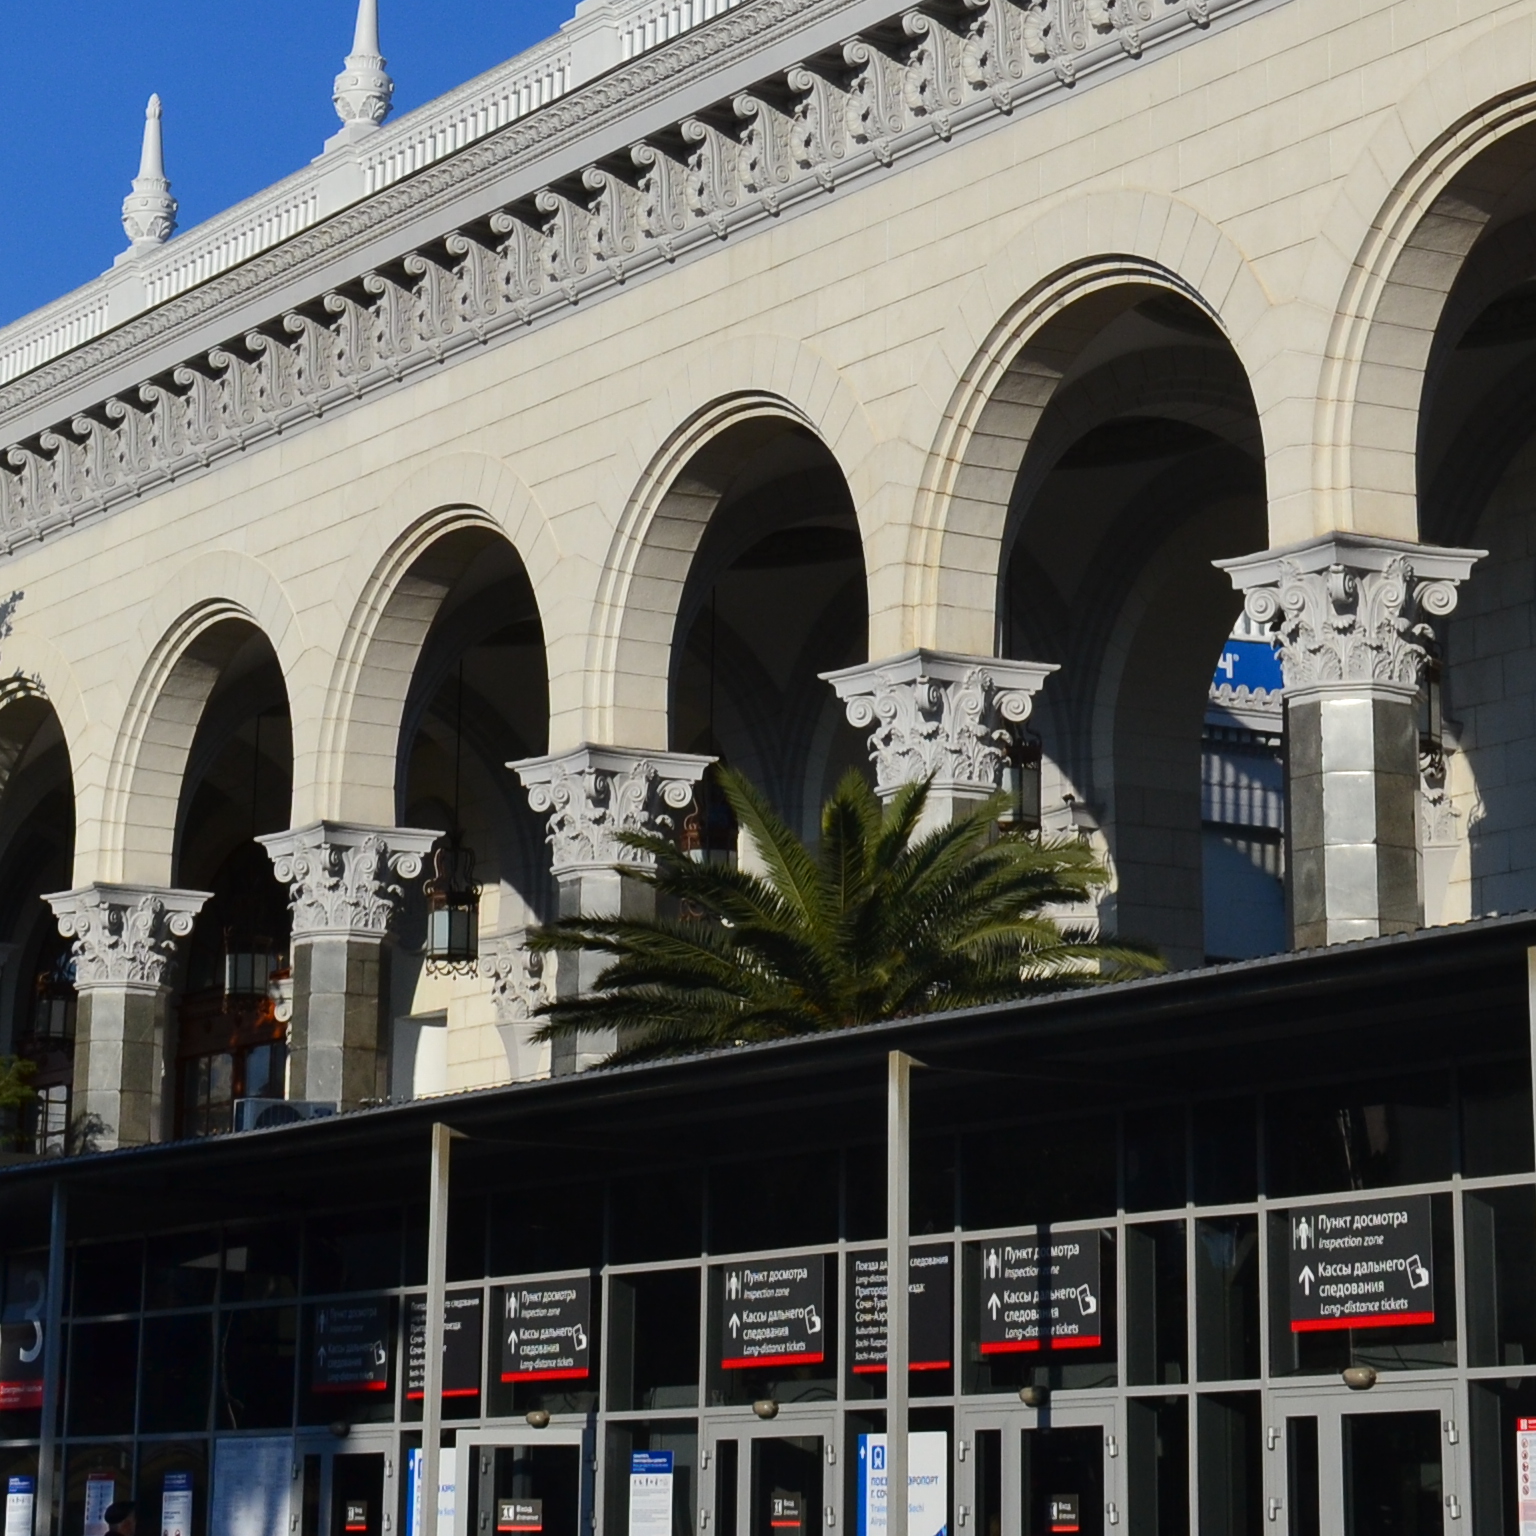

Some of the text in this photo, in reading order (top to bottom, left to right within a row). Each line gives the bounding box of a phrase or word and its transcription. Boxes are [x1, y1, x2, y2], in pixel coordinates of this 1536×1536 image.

[1318, 1211, 1408, 1233] Пункт досмотра
[1319, 1235, 1384, 1252] Inspection zone
[909, 1255, 949, 1268] следования
[1005, 1246, 1033, 1264] Пункт
[1318, 1258, 1406, 1278] Кассы дальнего
[744, 1268, 808, 1286] Пункт досмотра
[1004, 1290, 1032, 1304] Кассы
[1319, 1281, 1385, 1298] следования
[743, 1308, 804, 1323] Кассы дальнего
[1320, 1297, 1408, 1317] Long-distance tickets
[19, 1270, 45, 1362] 3
[743, 1326, 789, 1341] следования
[1056, 1323, 1079, 1335] tickets
